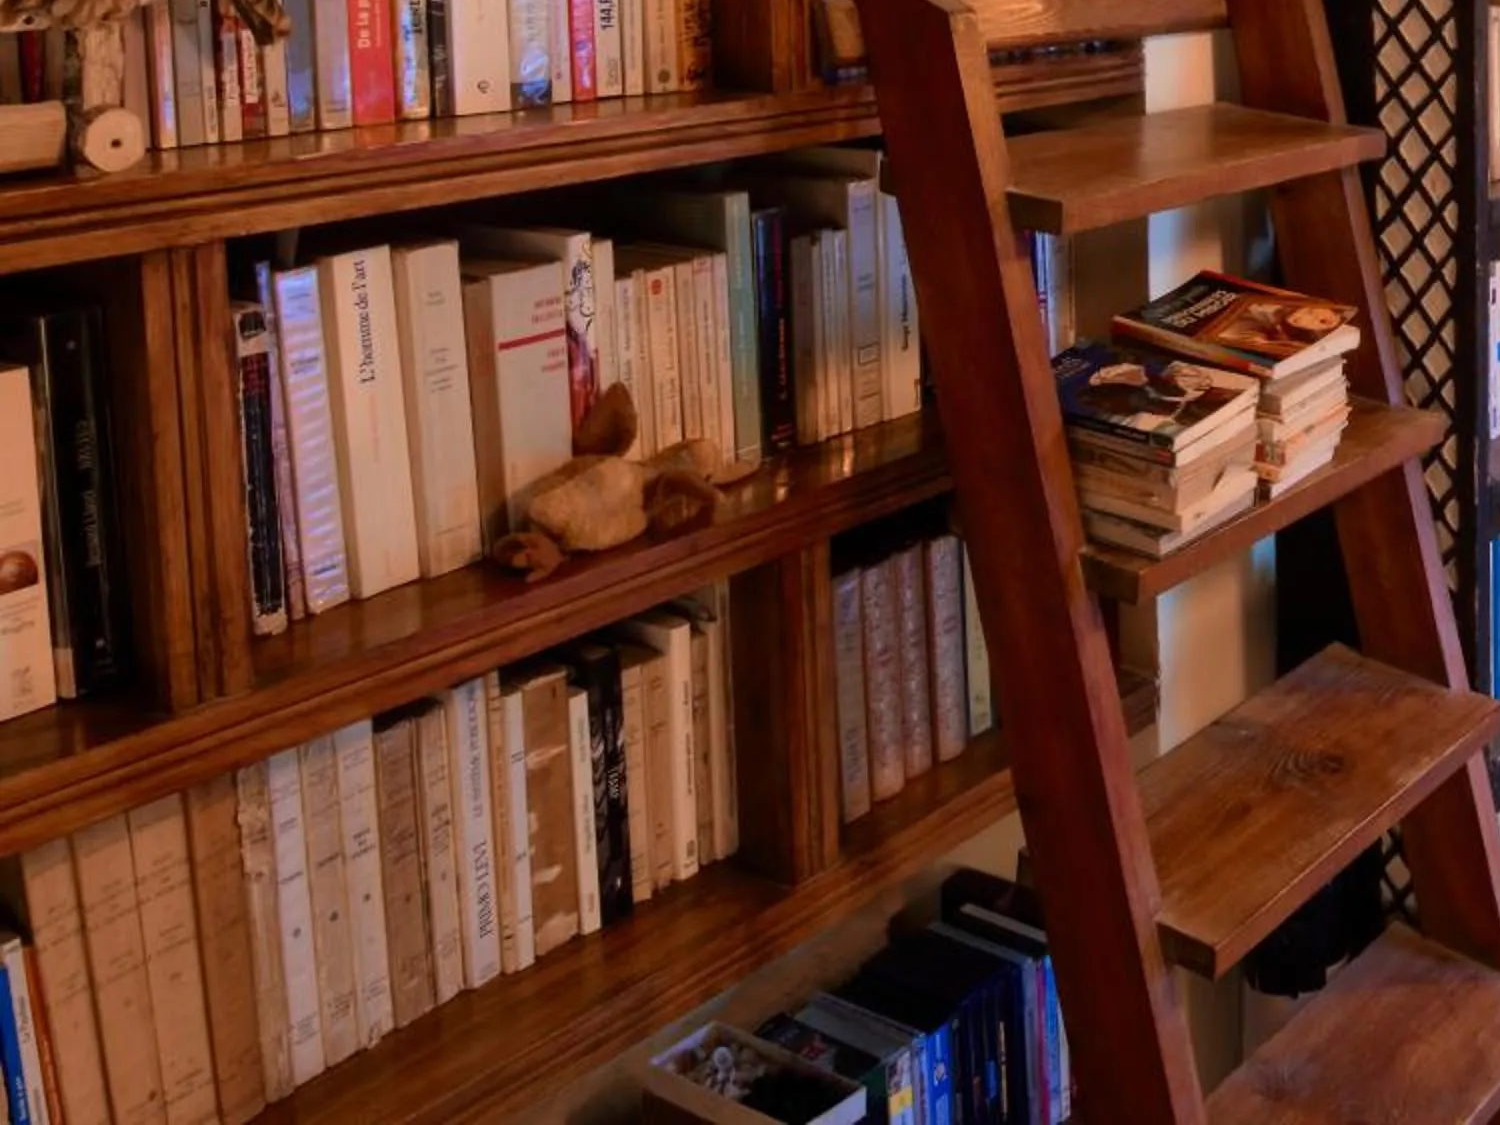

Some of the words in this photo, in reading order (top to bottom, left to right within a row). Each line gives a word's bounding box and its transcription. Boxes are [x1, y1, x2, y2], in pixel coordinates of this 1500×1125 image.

[355, 11, 369, 26] la
[356, 29, 371, 49] De
[350, 259, 368, 291] l'art
[354, 292, 369, 311] de
[355, 312, 376, 384] L'homme
[471, 839, 491, 879] LEVI
[475, 883, 496, 939] PRIMO
